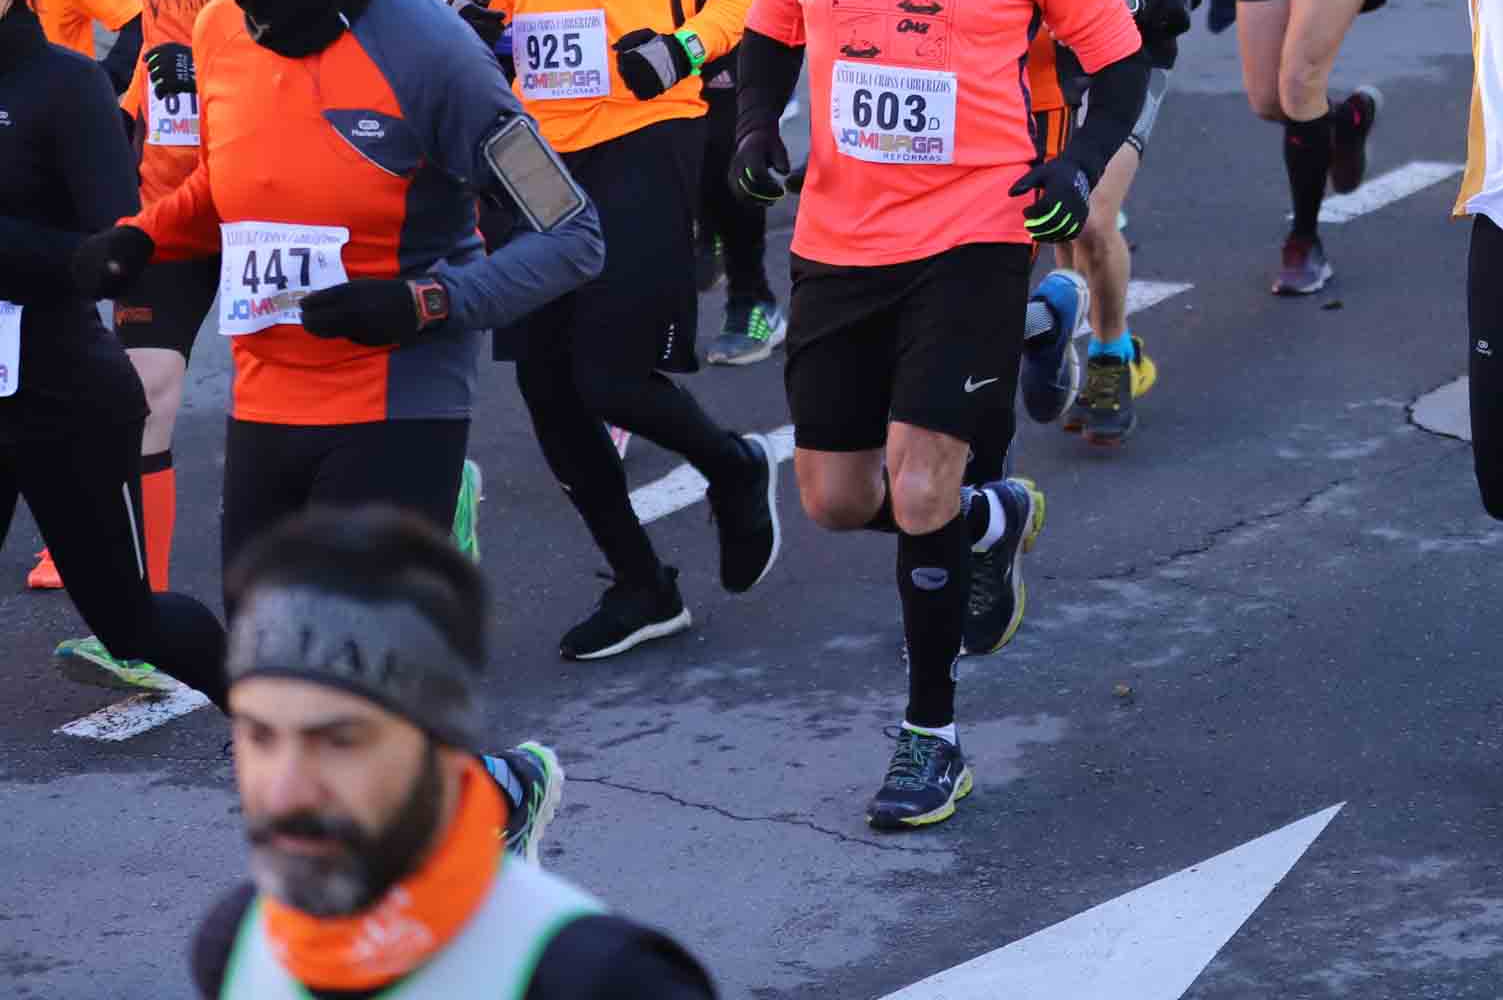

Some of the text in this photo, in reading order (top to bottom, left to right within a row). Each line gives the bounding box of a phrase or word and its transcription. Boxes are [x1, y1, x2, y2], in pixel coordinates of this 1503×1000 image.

[527, 32, 584, 70] 925
[852, 88, 927, 133] 603
[242, 247, 312, 294] 447
